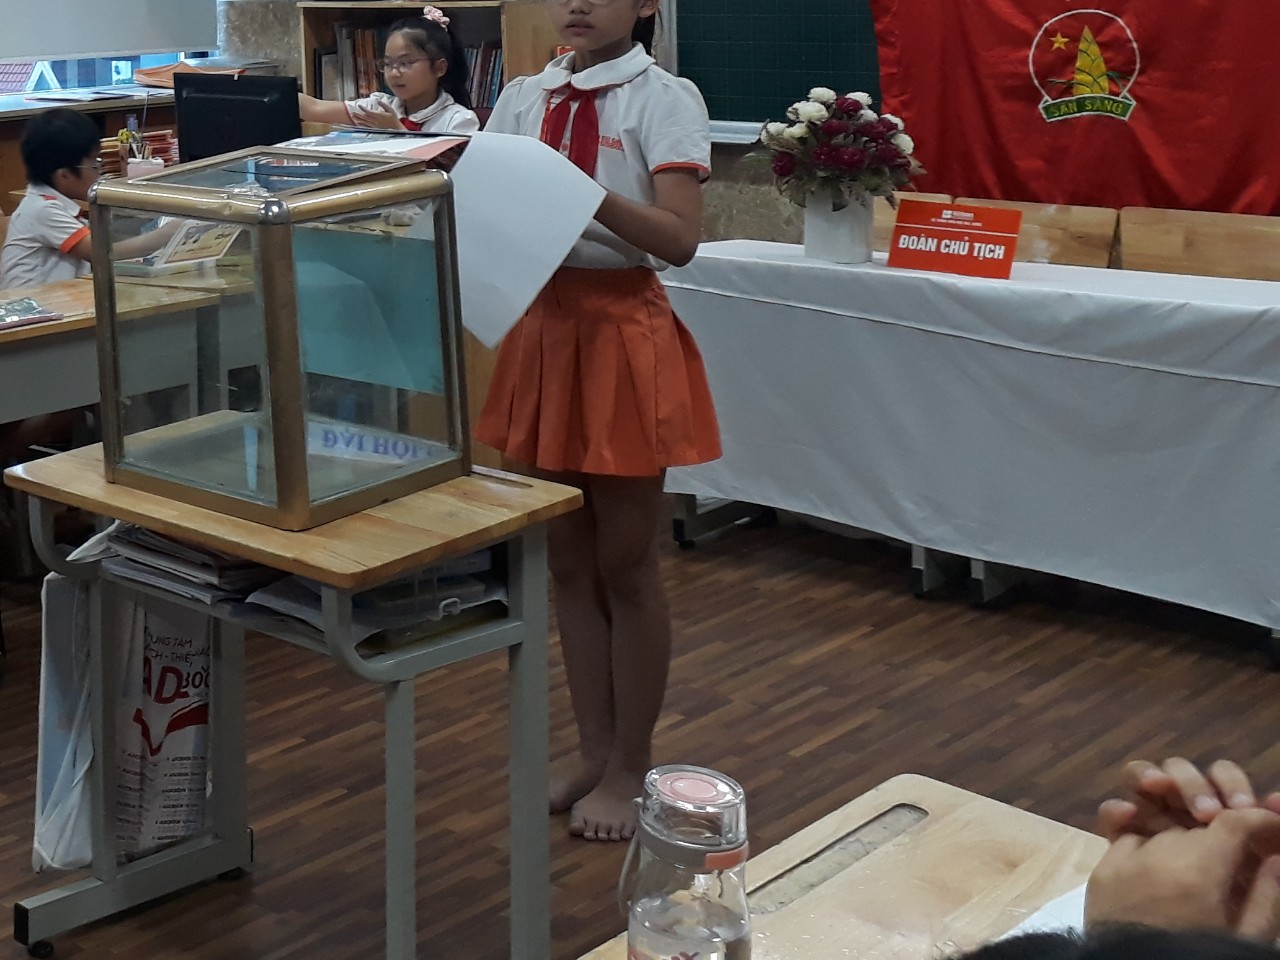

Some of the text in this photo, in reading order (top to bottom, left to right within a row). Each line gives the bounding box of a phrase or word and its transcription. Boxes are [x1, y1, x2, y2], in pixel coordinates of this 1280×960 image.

[898, 233, 1006, 261] ĐOÀN CHỦ TỊCH
